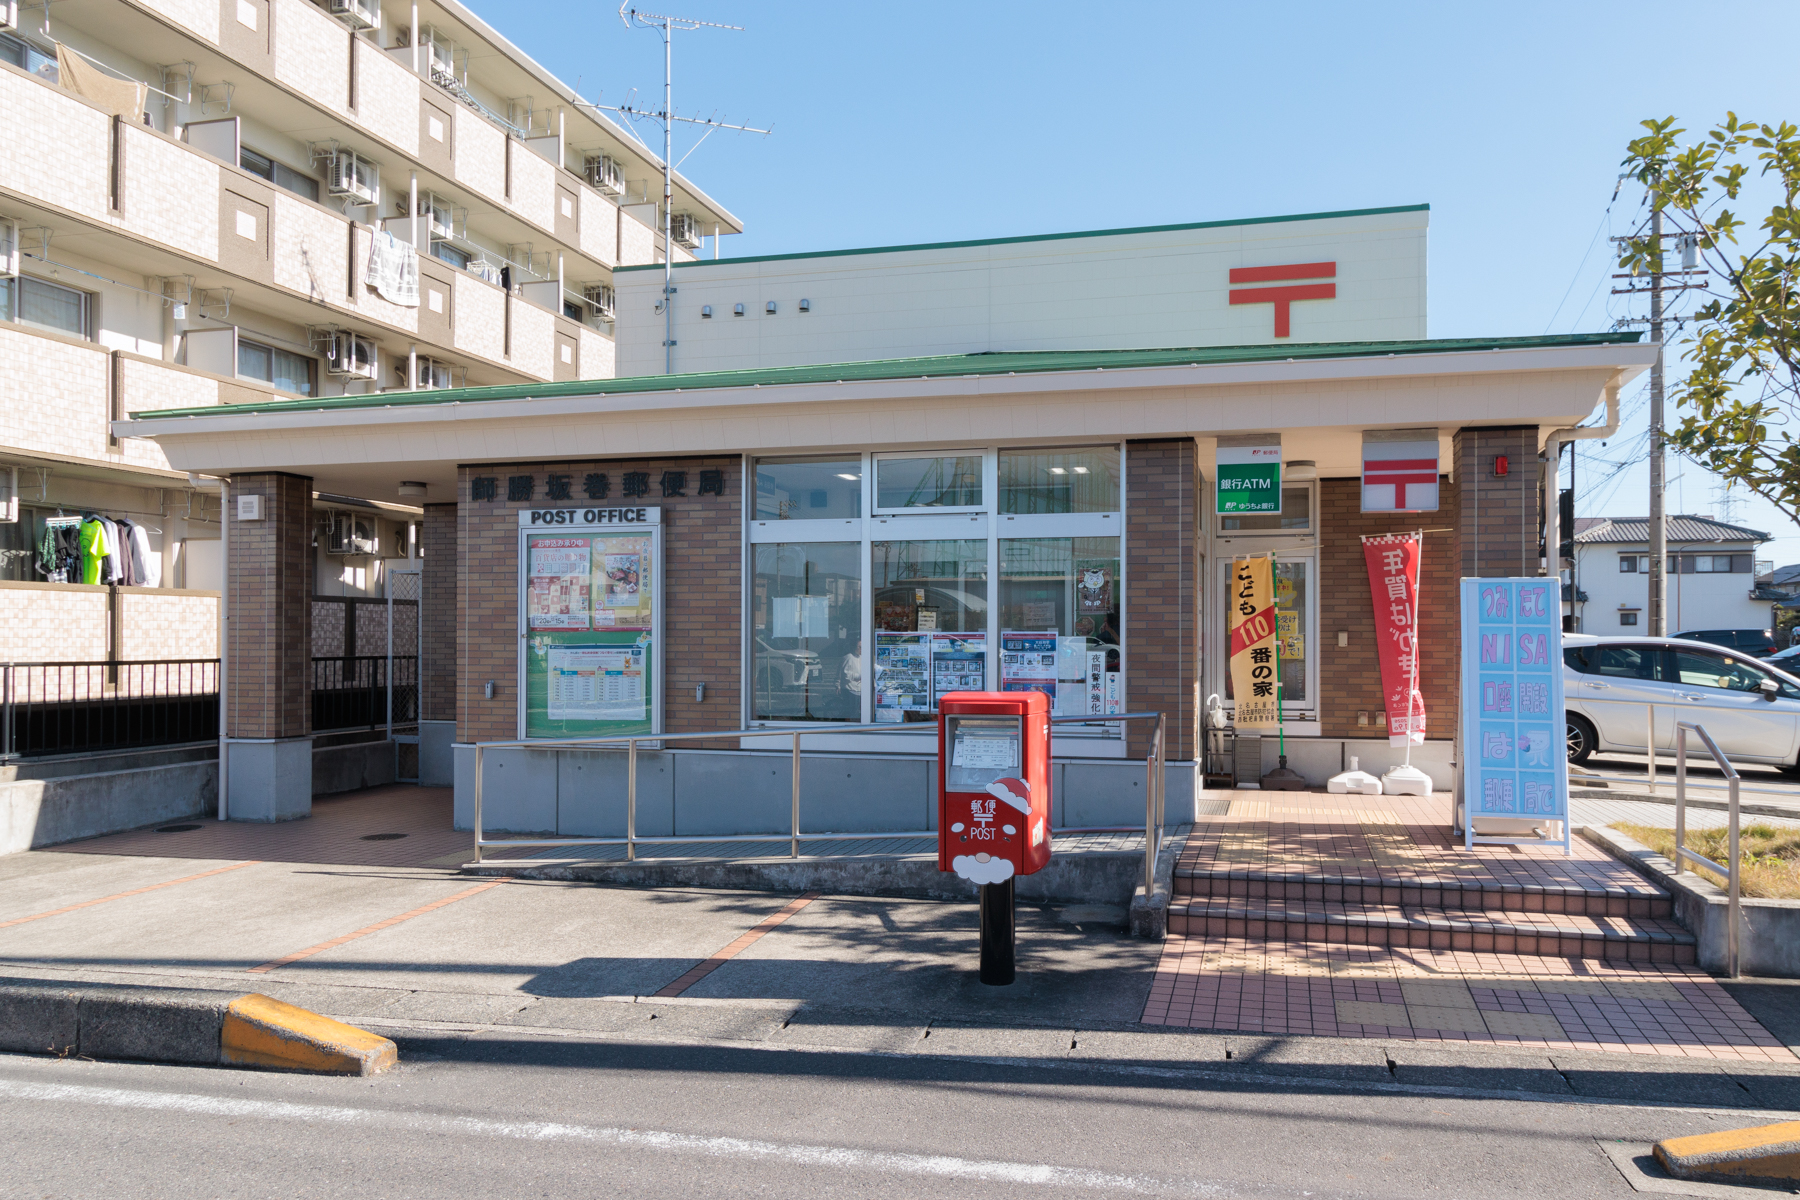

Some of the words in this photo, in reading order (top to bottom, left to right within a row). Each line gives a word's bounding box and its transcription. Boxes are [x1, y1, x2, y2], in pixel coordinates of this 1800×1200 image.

[472, 470, 726, 502] 師勝坂巻郵便局
[1220, 478, 1270, 490] 銀行ATM
[531, 510, 576, 525] POST
[584, 508, 647, 523] OFFICE
[1482, 585, 1546, 618] つみたて
[1482, 633, 1548, 665] NISA
[1091, 654, 1101, 715] 夜間警戒強化
[1484, 680, 1549, 714] 口座開設
[1483, 731, 1513, 759] は
[971, 800, 996, 815] 郵便
[1484, 778, 1553, 813] 郵便局で
[971, 828, 996, 840] POST
